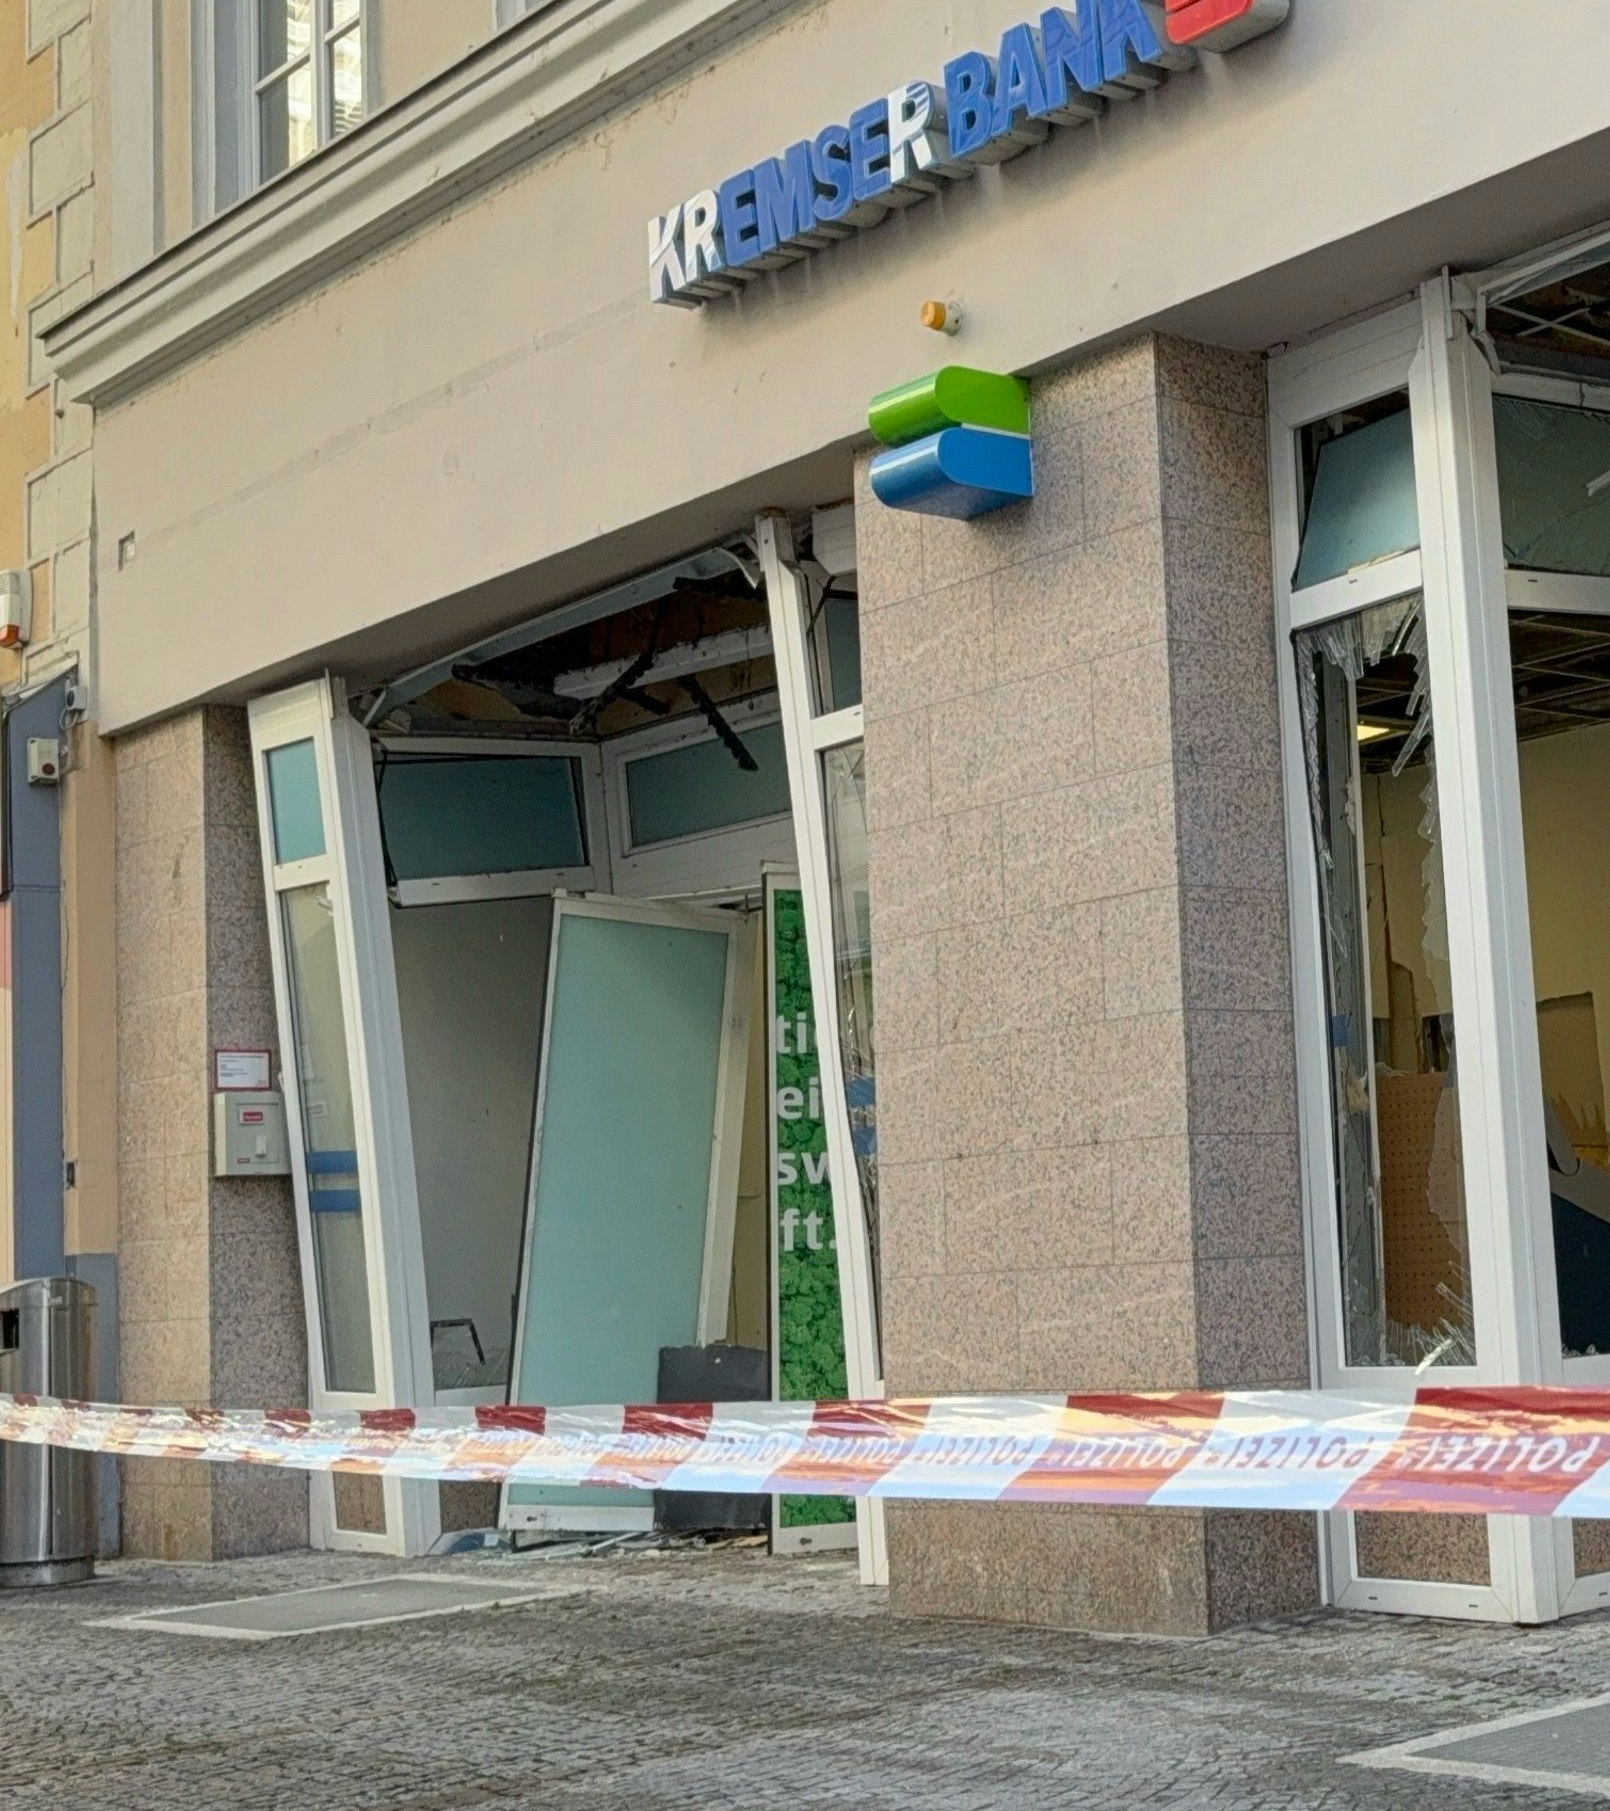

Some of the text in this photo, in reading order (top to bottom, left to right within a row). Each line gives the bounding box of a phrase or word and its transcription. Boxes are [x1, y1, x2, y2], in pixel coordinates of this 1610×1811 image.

[648, 0, 1164, 304] KREMSER BANK
[777, 1012, 817, 1054] ti
[1222, 1436, 1376, 1469] POLIZEI
[1415, 1436, 1600, 1475] POLIZEI
